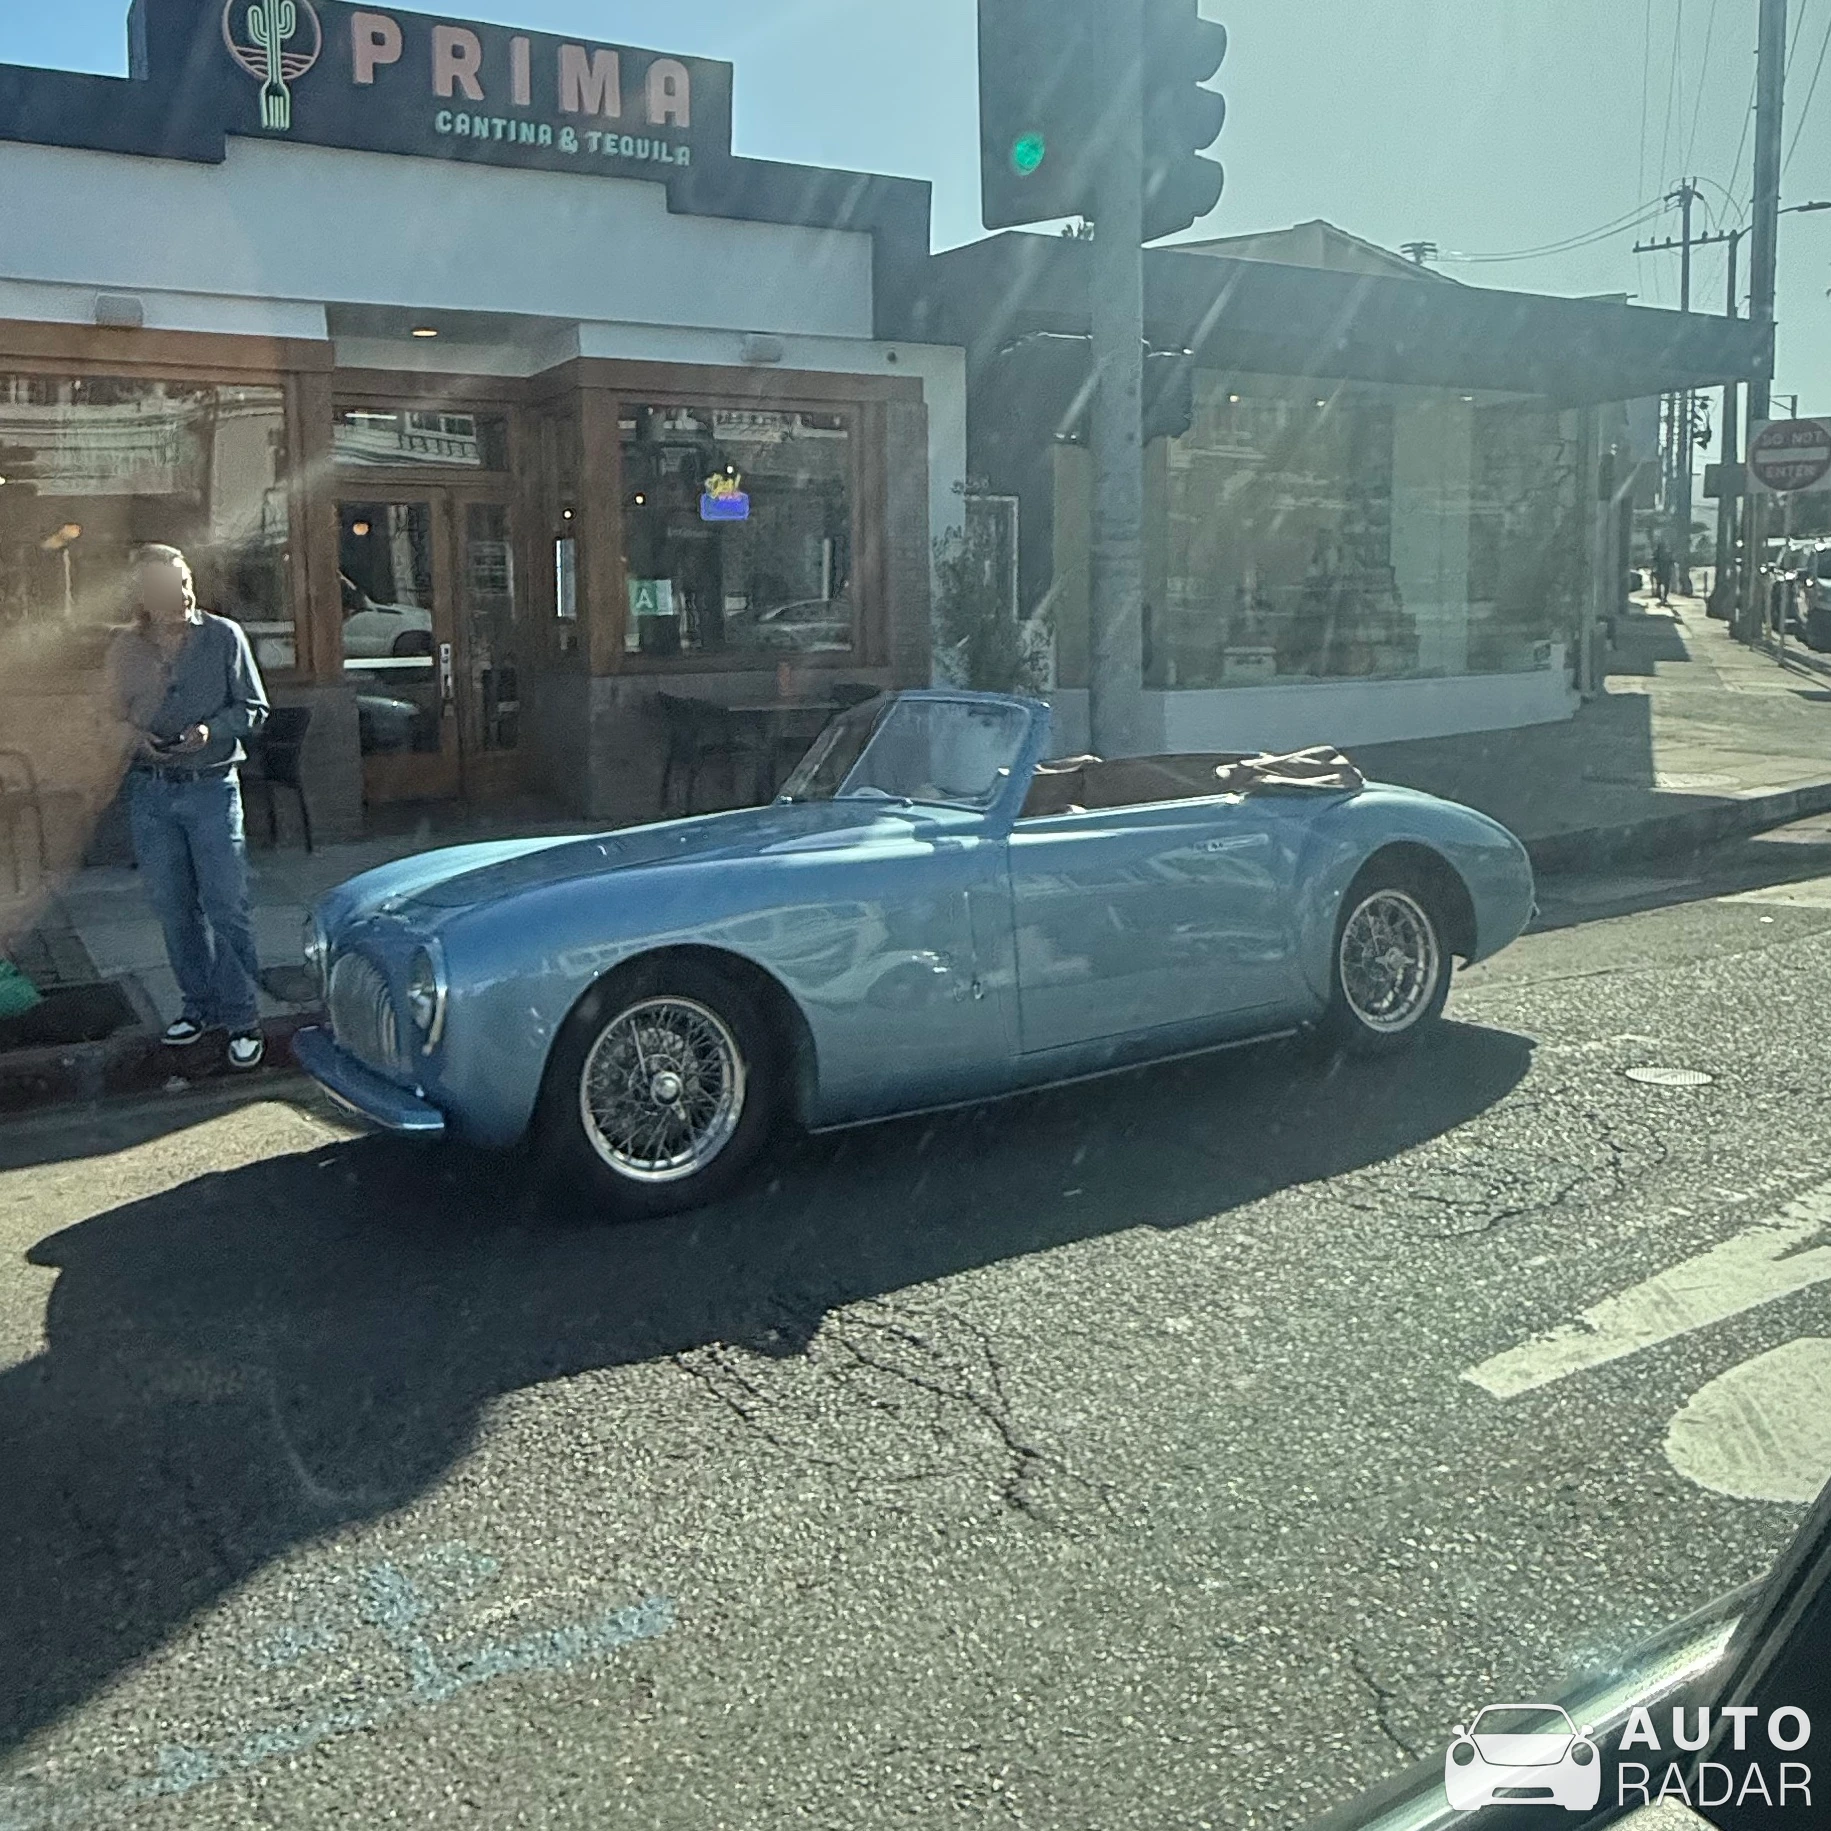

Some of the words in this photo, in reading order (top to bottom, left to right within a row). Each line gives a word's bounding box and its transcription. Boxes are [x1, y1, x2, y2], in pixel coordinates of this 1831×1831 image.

[350, 11, 691, 129] PRIMA
[434, 109, 553, 147] CANTINA
[558, 126, 578, 155] &
[585, 131, 690, 166] TEQUILA
[1761, 433, 1785, 446] DO
[1791, 430, 1824, 444] NOT
[1764, 464, 1817, 478] ENTER
[635, 587, 654, 609] A
